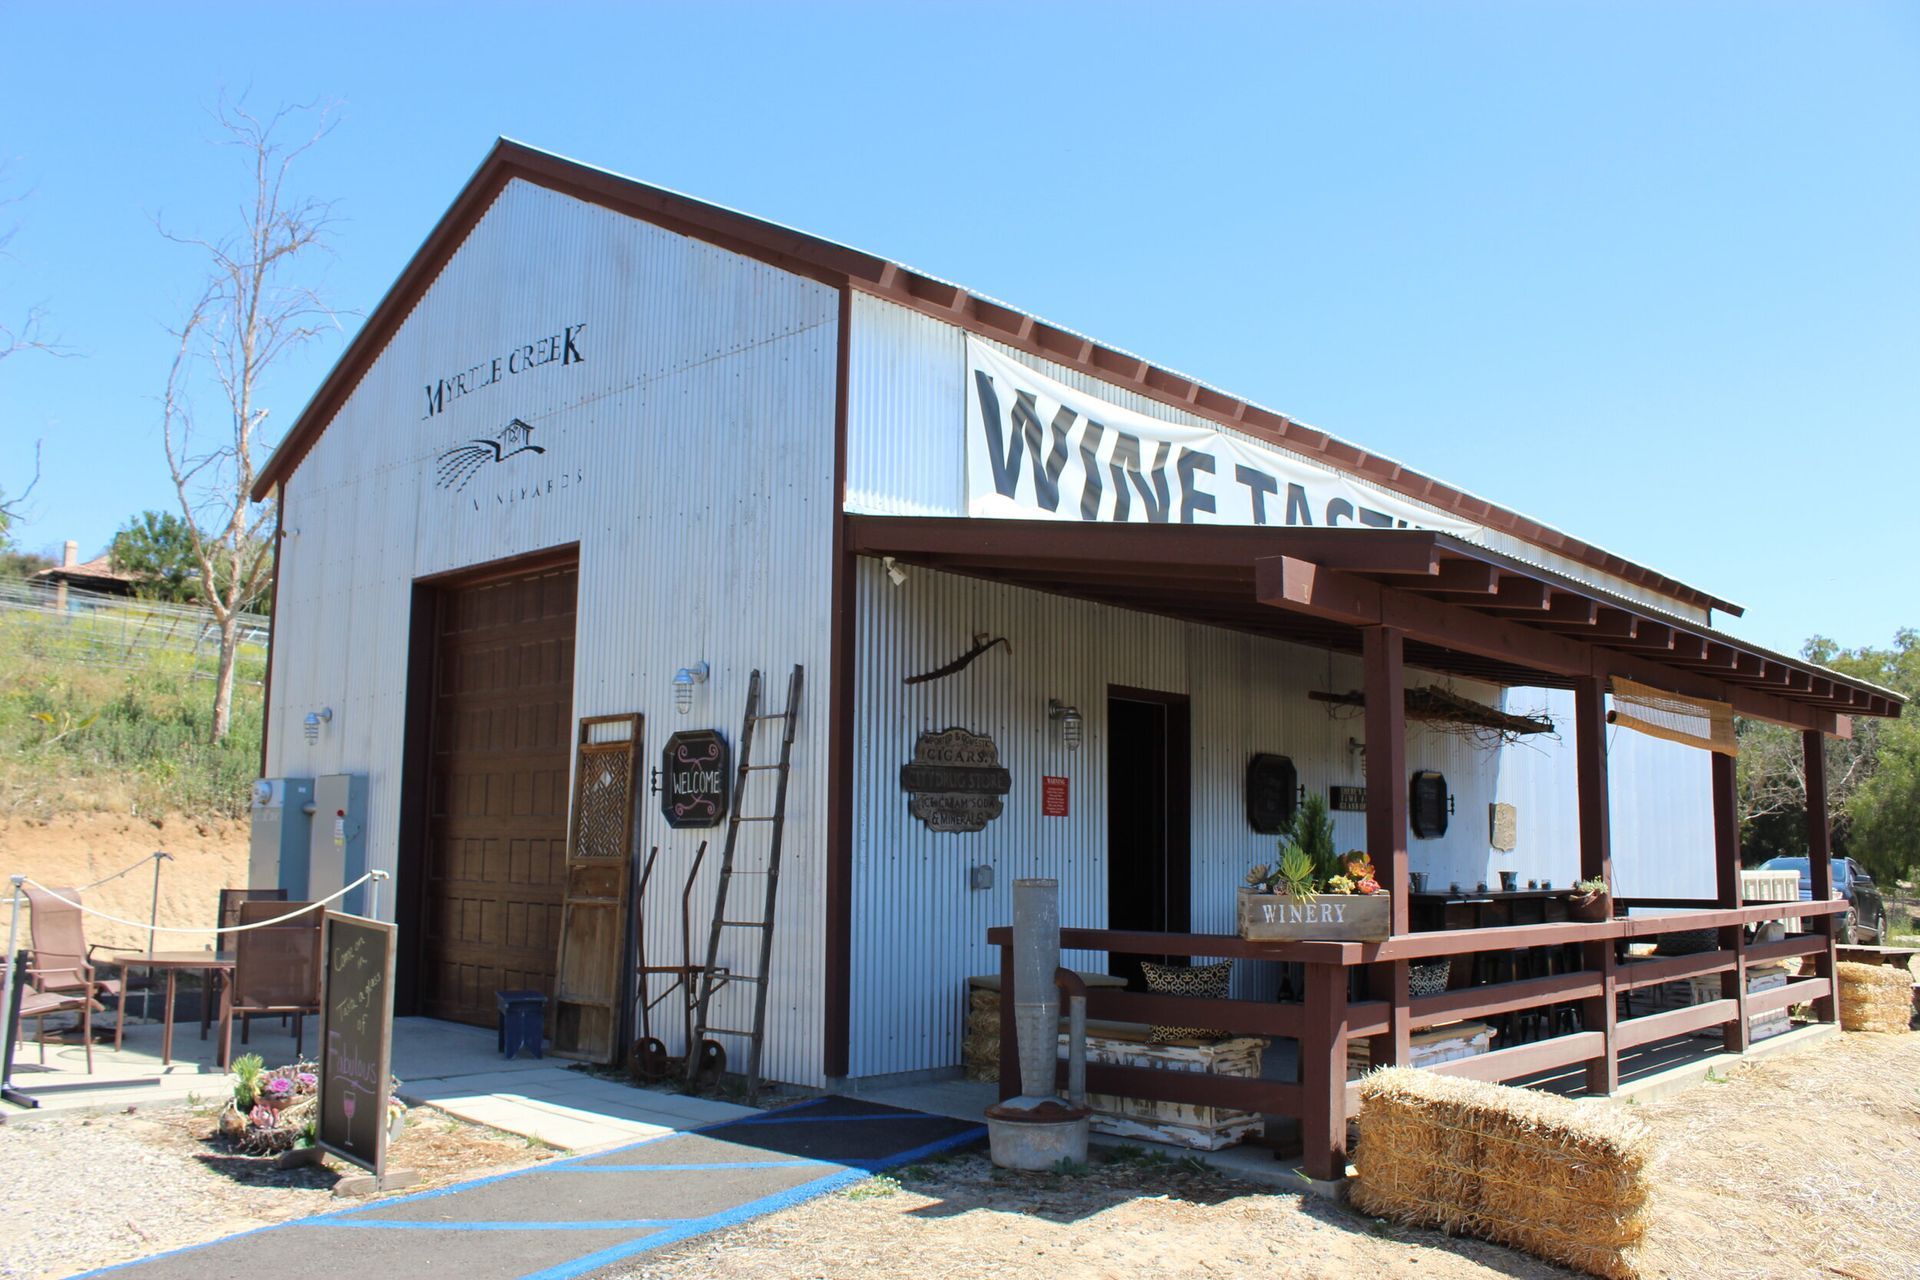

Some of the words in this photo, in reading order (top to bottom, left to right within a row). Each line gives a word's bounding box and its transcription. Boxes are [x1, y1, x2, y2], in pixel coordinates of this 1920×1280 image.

[422, 358, 502, 420] MYRTLE
[509, 323, 586, 374] CREEK
[974, 369, 1216, 524] WINE
[673, 770, 720, 794] WELCOME
[936, 771, 967, 789] DRUG
[968, 772, 1006, 790] STORE
[969, 798, 995, 809] SODA
[932, 812, 940, 825] &
[941, 812, 984, 826] MINERALS
[1262, 904, 1347, 924] WINERY
[334, 947, 355, 972] Come
[354, 936, 366, 951] on
[357, 956, 368, 969] in
[359, 991, 366, 1002] a
[357, 1013, 368, 1035] of
[328, 1029, 377, 1084] Fabulous
